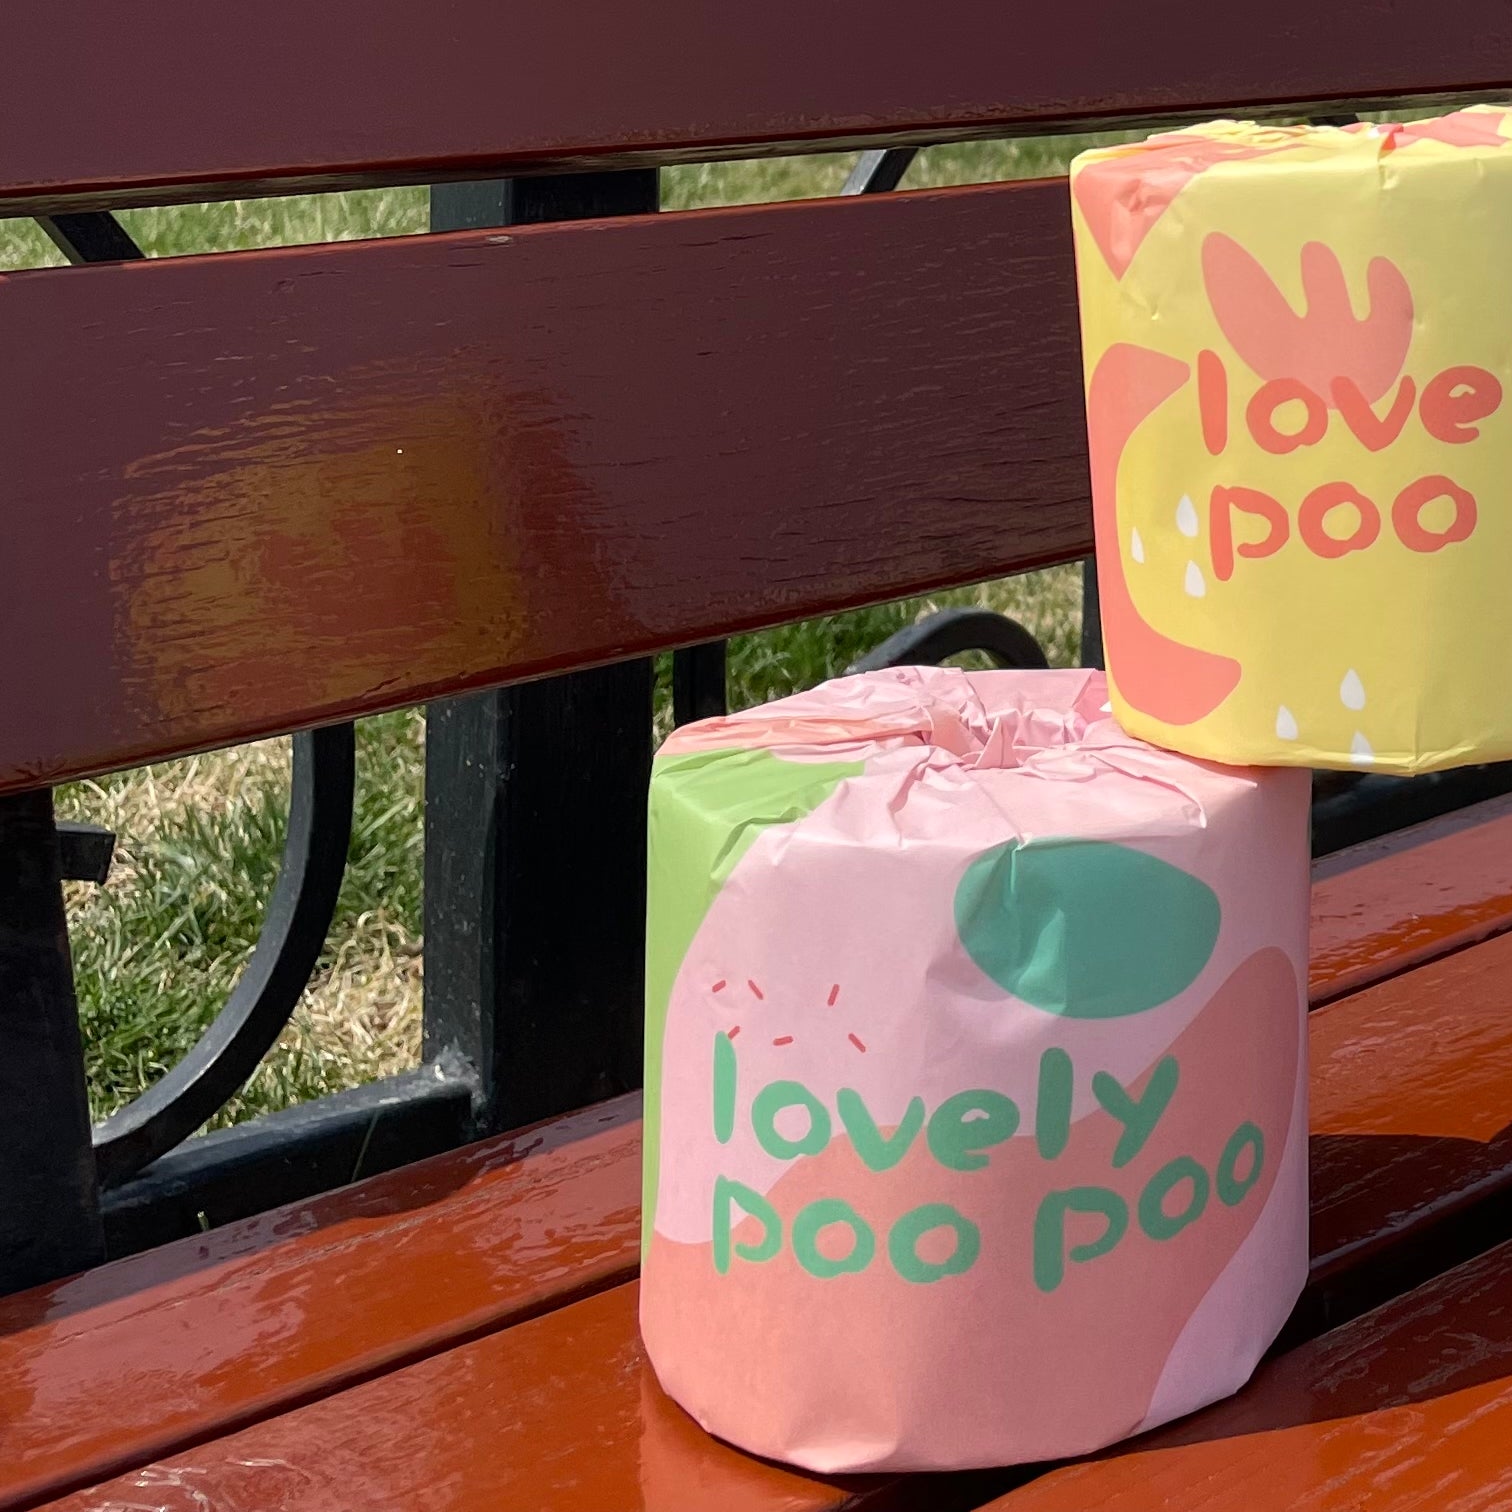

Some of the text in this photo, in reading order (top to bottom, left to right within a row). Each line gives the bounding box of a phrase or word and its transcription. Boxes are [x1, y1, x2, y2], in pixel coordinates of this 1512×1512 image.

[1207, 474, 1478, 581] poo
[712, 1031, 1181, 1172] lovely
[712, 1119, 1265, 1292] poo poo
